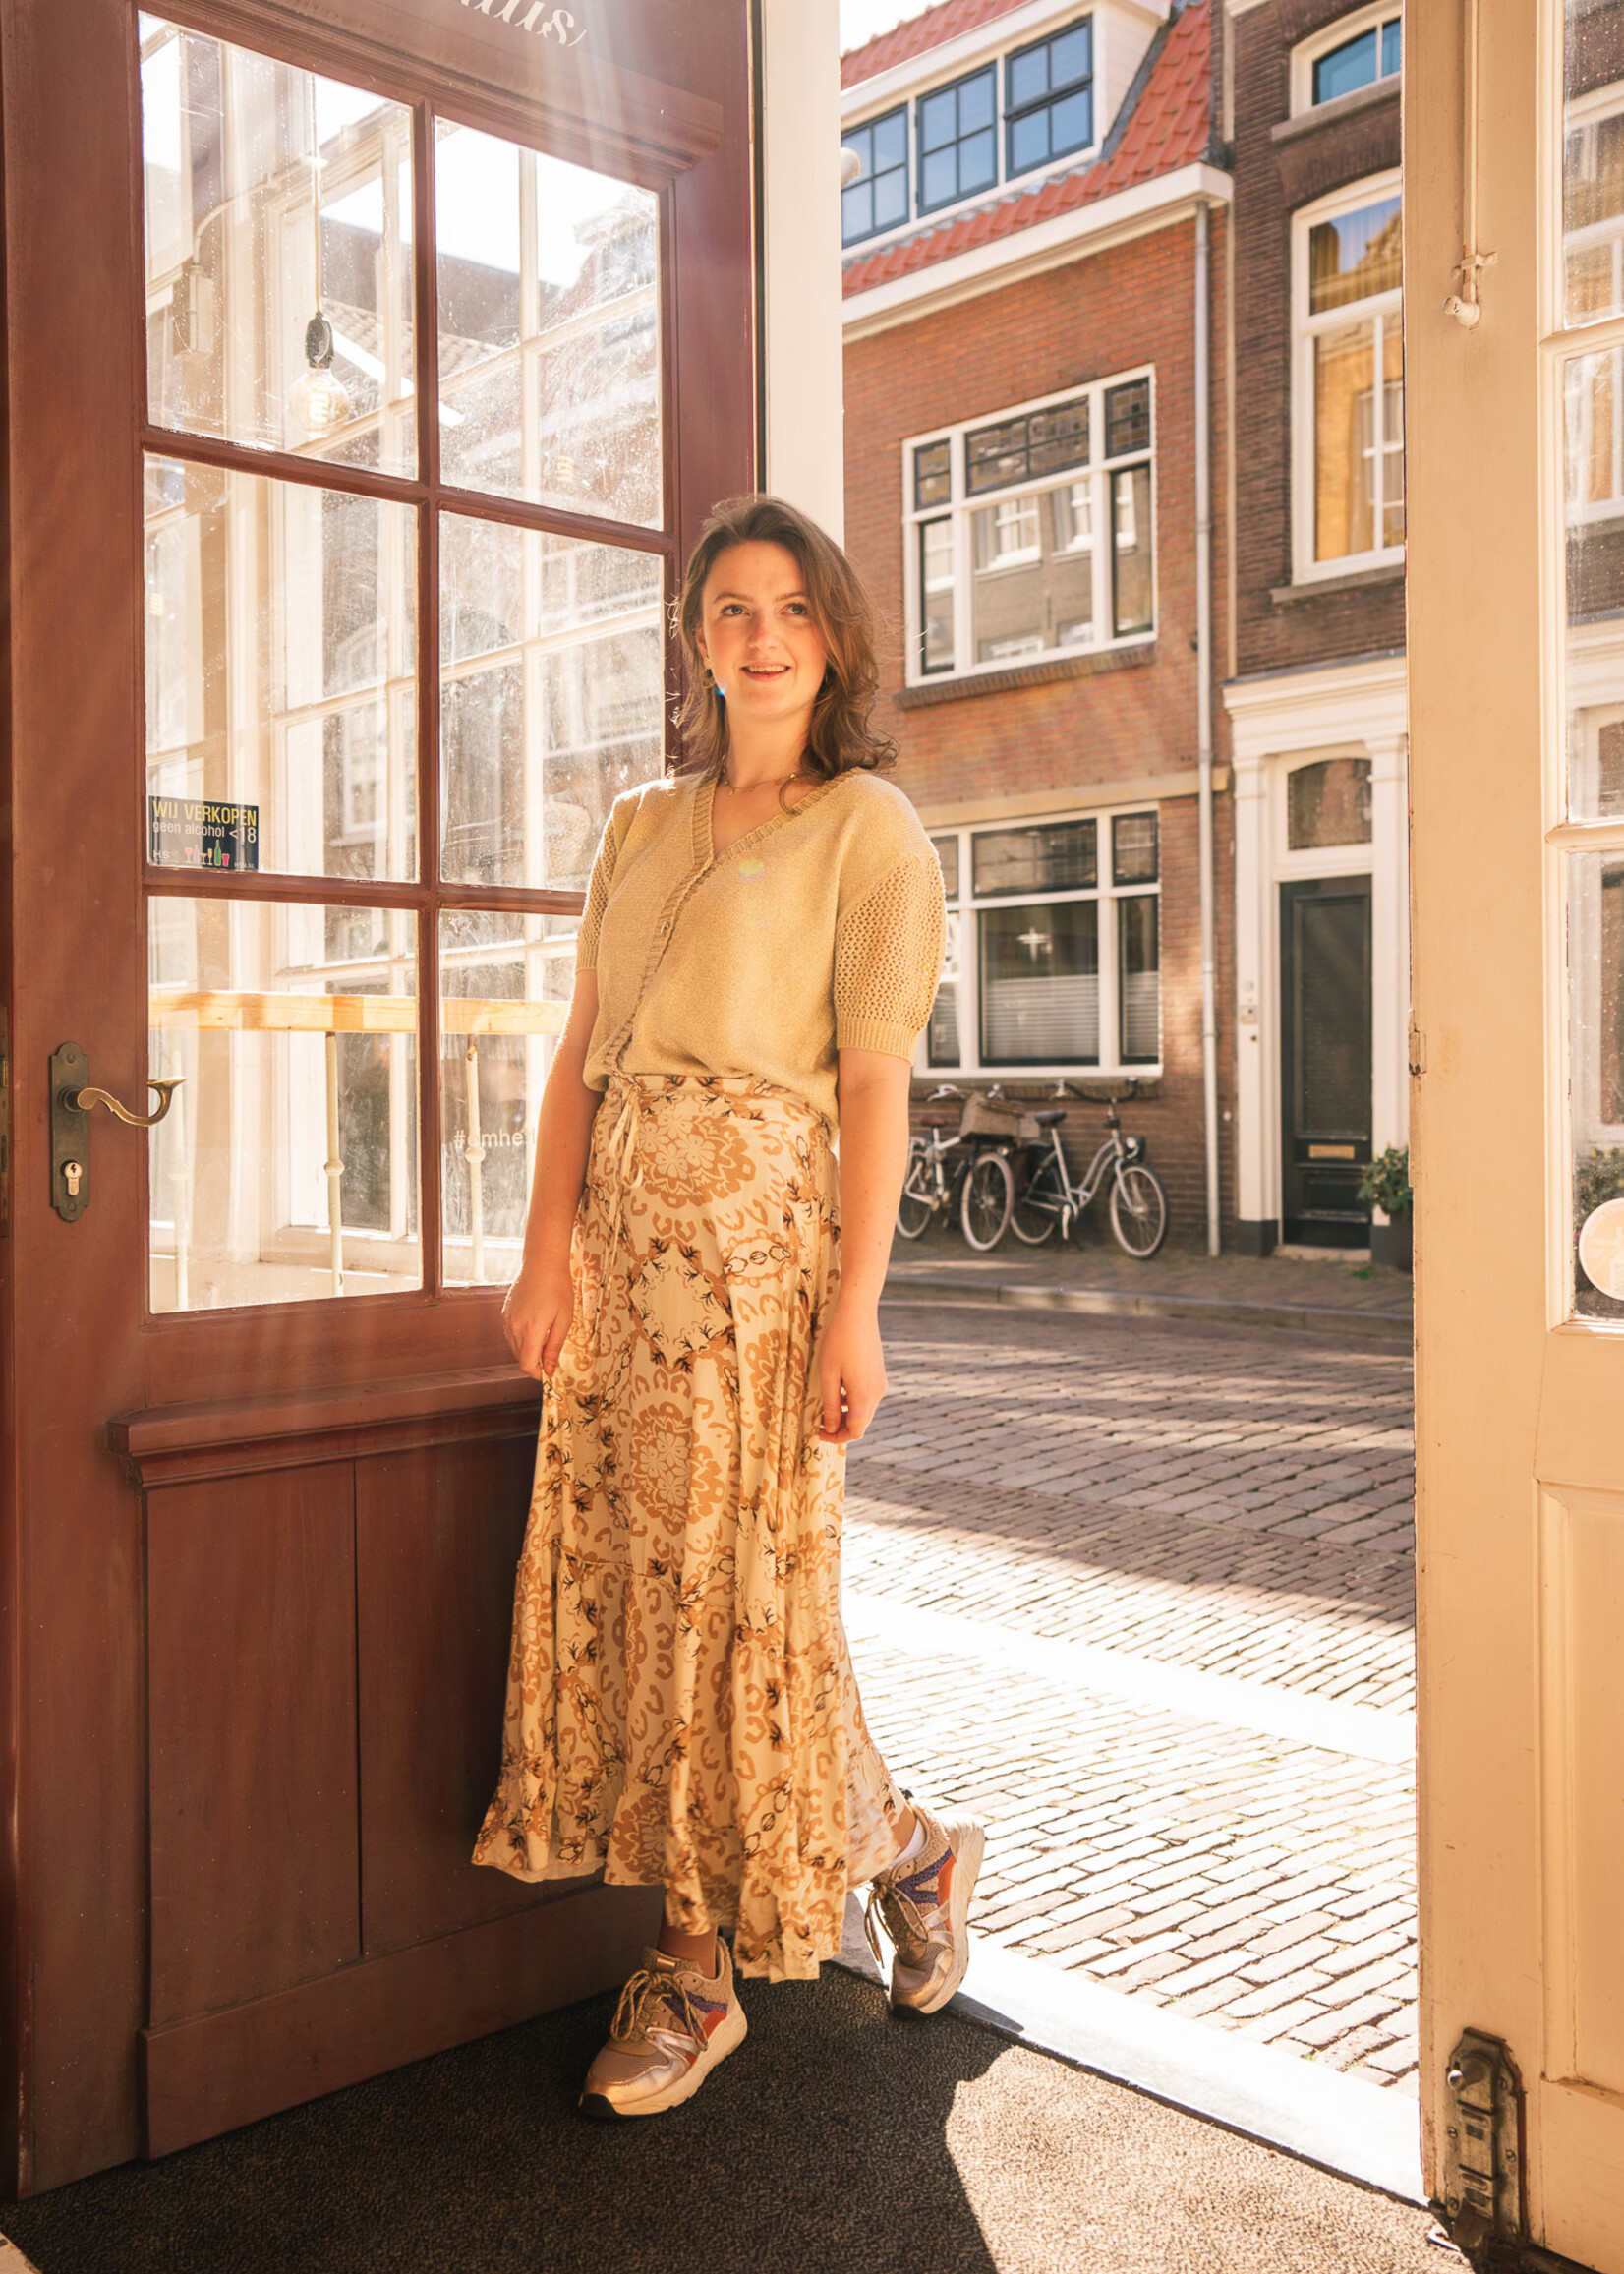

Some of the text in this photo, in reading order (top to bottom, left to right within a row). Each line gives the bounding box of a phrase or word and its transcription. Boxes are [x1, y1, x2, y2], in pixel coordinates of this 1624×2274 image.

[152, 801, 257, 826] WIJ VERKOPEN
[152, 821, 257, 844] geen alcohol <18
